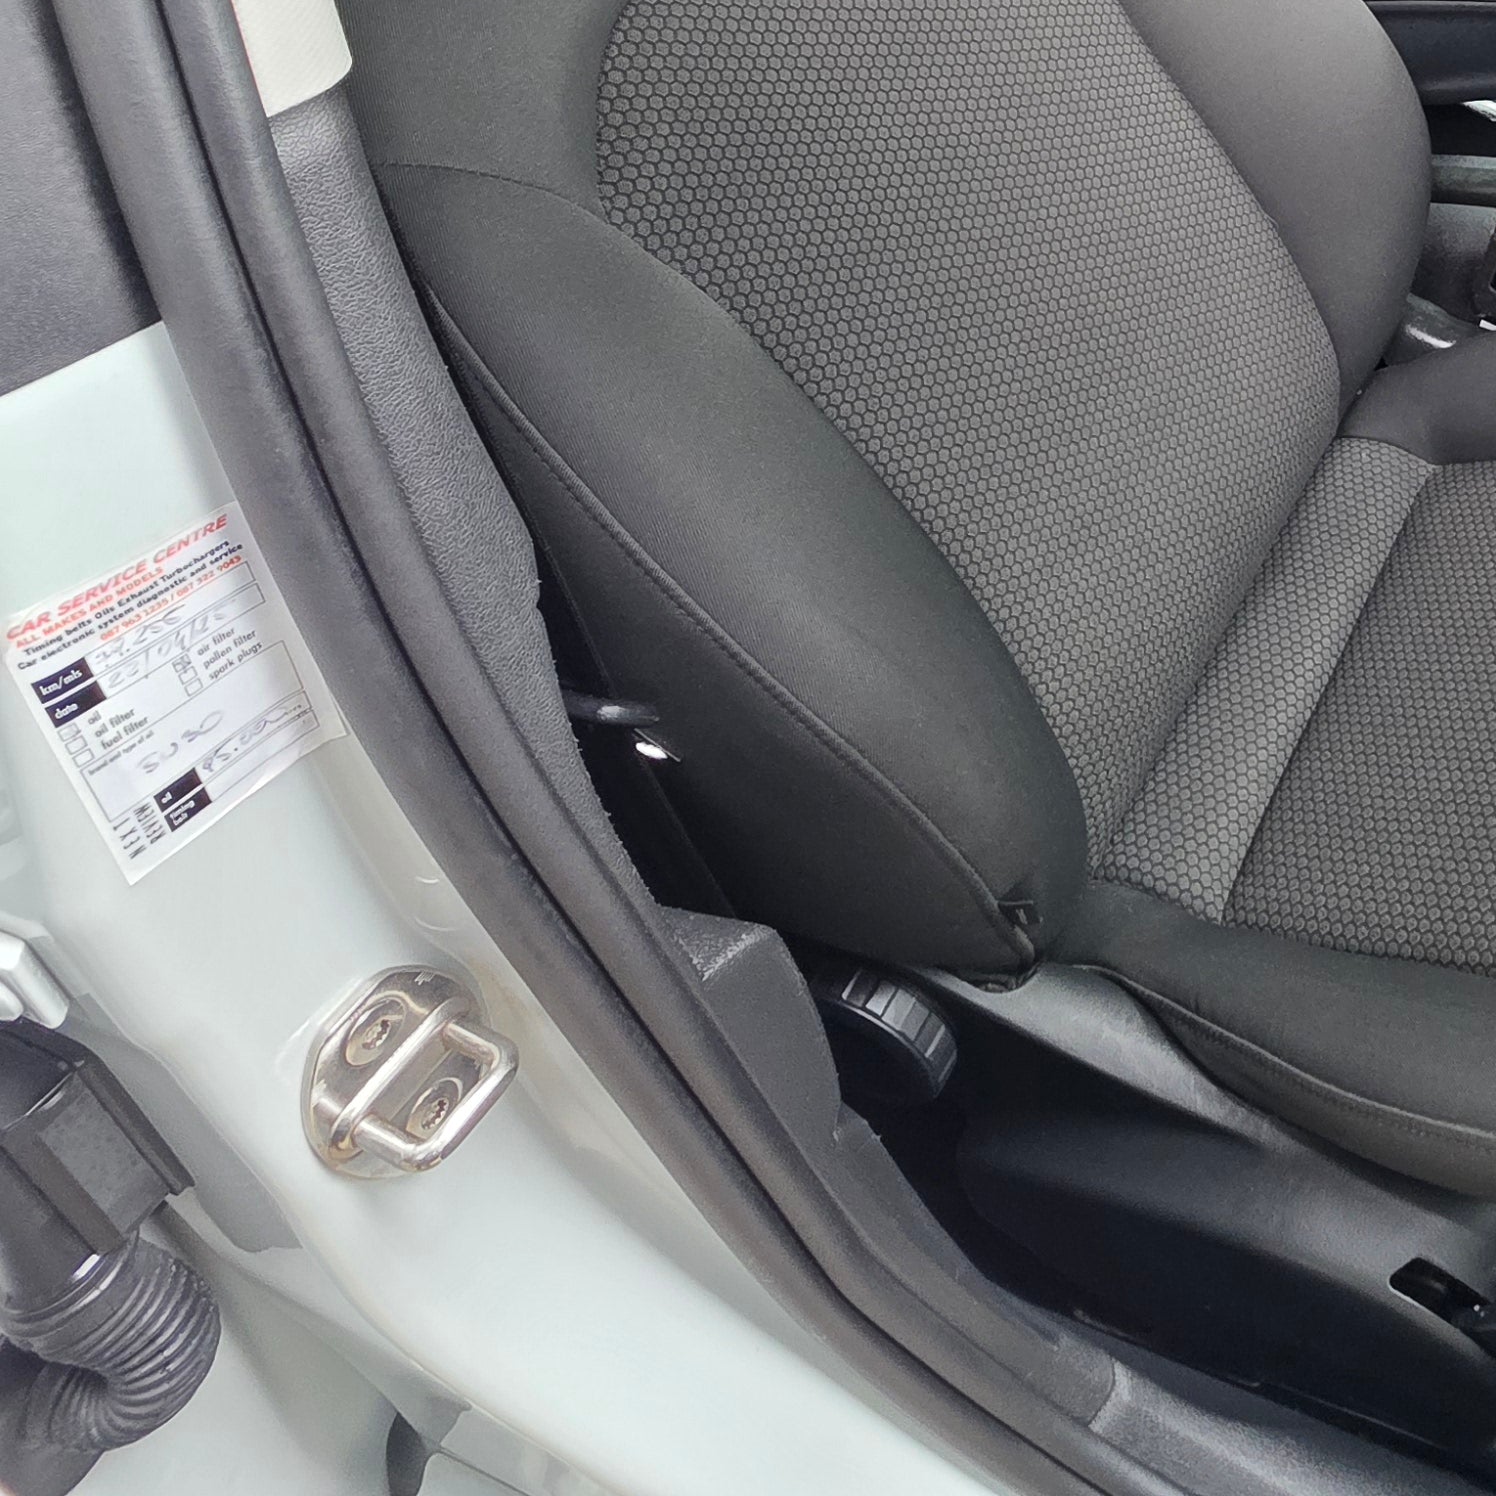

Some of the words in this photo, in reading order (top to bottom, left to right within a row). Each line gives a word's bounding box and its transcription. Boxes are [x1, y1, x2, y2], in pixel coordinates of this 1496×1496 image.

[6, 610, 51, 640] CAR
[57, 559, 147, 617] SERVICE
[153, 513, 228, 564] CENTRE
[16, 635, 41, 649] ALL
[42, 608, 87, 636] MAKES
[89, 595, 113, 612] AND
[115, 566, 163, 597] MODELS
[17, 659, 37, 671] Car
[41, 628, 95, 661] electronic
[98, 606, 134, 631] system
[136, 575, 187, 608] diagnostic
[189, 563, 207, 578] and
[209, 543, 243, 565] service
[23, 635, 63, 656] Timing
[66, 619, 92, 636] belts
[95, 606, 115, 620] Oils
[117, 580, 159, 608] Exhaust
[160, 540, 230, 582] Turbochargers
[196, 644, 210, 656] air
[212, 628, 235, 646] filter
[202, 645, 232, 670] pollen
[233, 630, 257, 648] filter
[208, 658, 235, 680] spark
[237, 642, 263, 663] plugs
[88, 710, 102, 725] oil
[95, 723, 109, 738] oil
[109, 708, 136, 728] filter
[101, 731, 123, 750] fuel
[123, 716, 149, 736] filter
[112, 817, 148, 860] NEXT
[132, 801, 167, 845] REVIEW
